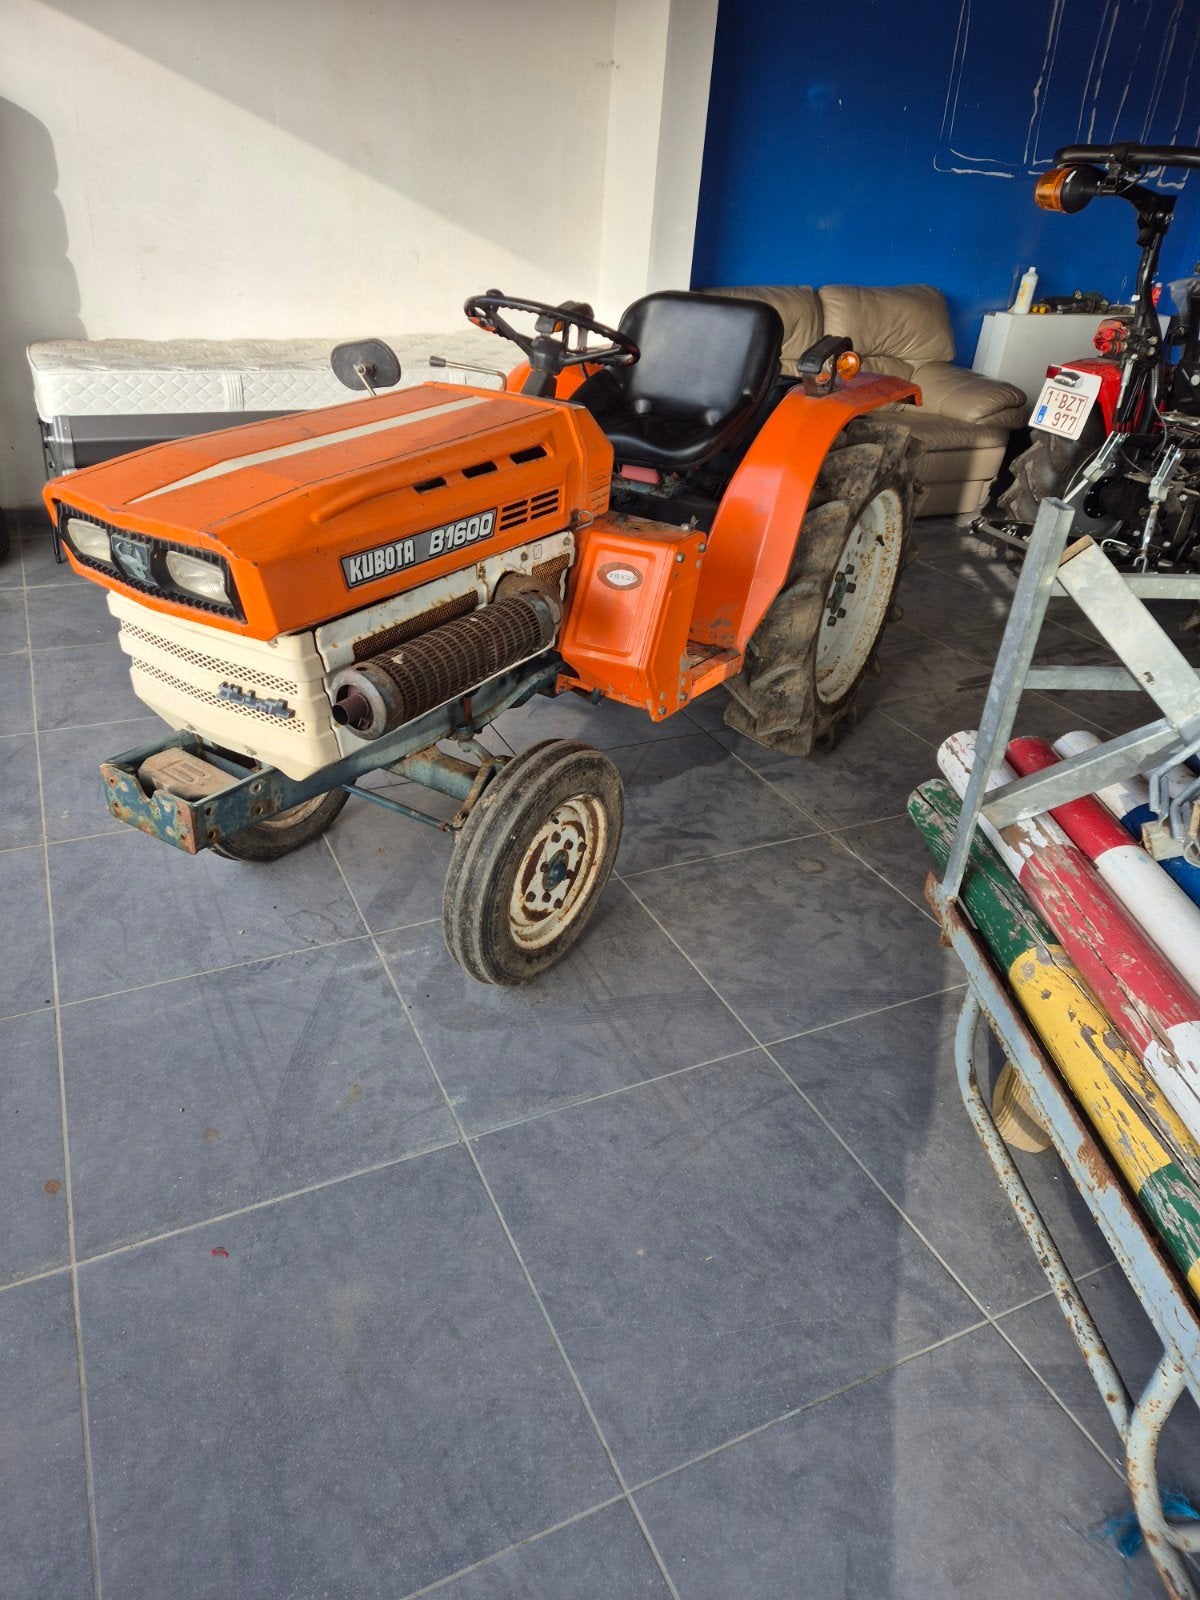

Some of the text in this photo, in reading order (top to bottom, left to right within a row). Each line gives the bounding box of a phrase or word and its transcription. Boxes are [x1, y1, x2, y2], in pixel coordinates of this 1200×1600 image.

[1051, 411, 1077, 431] 977
[349, 512, 495, 584] KUBOTA B1600
